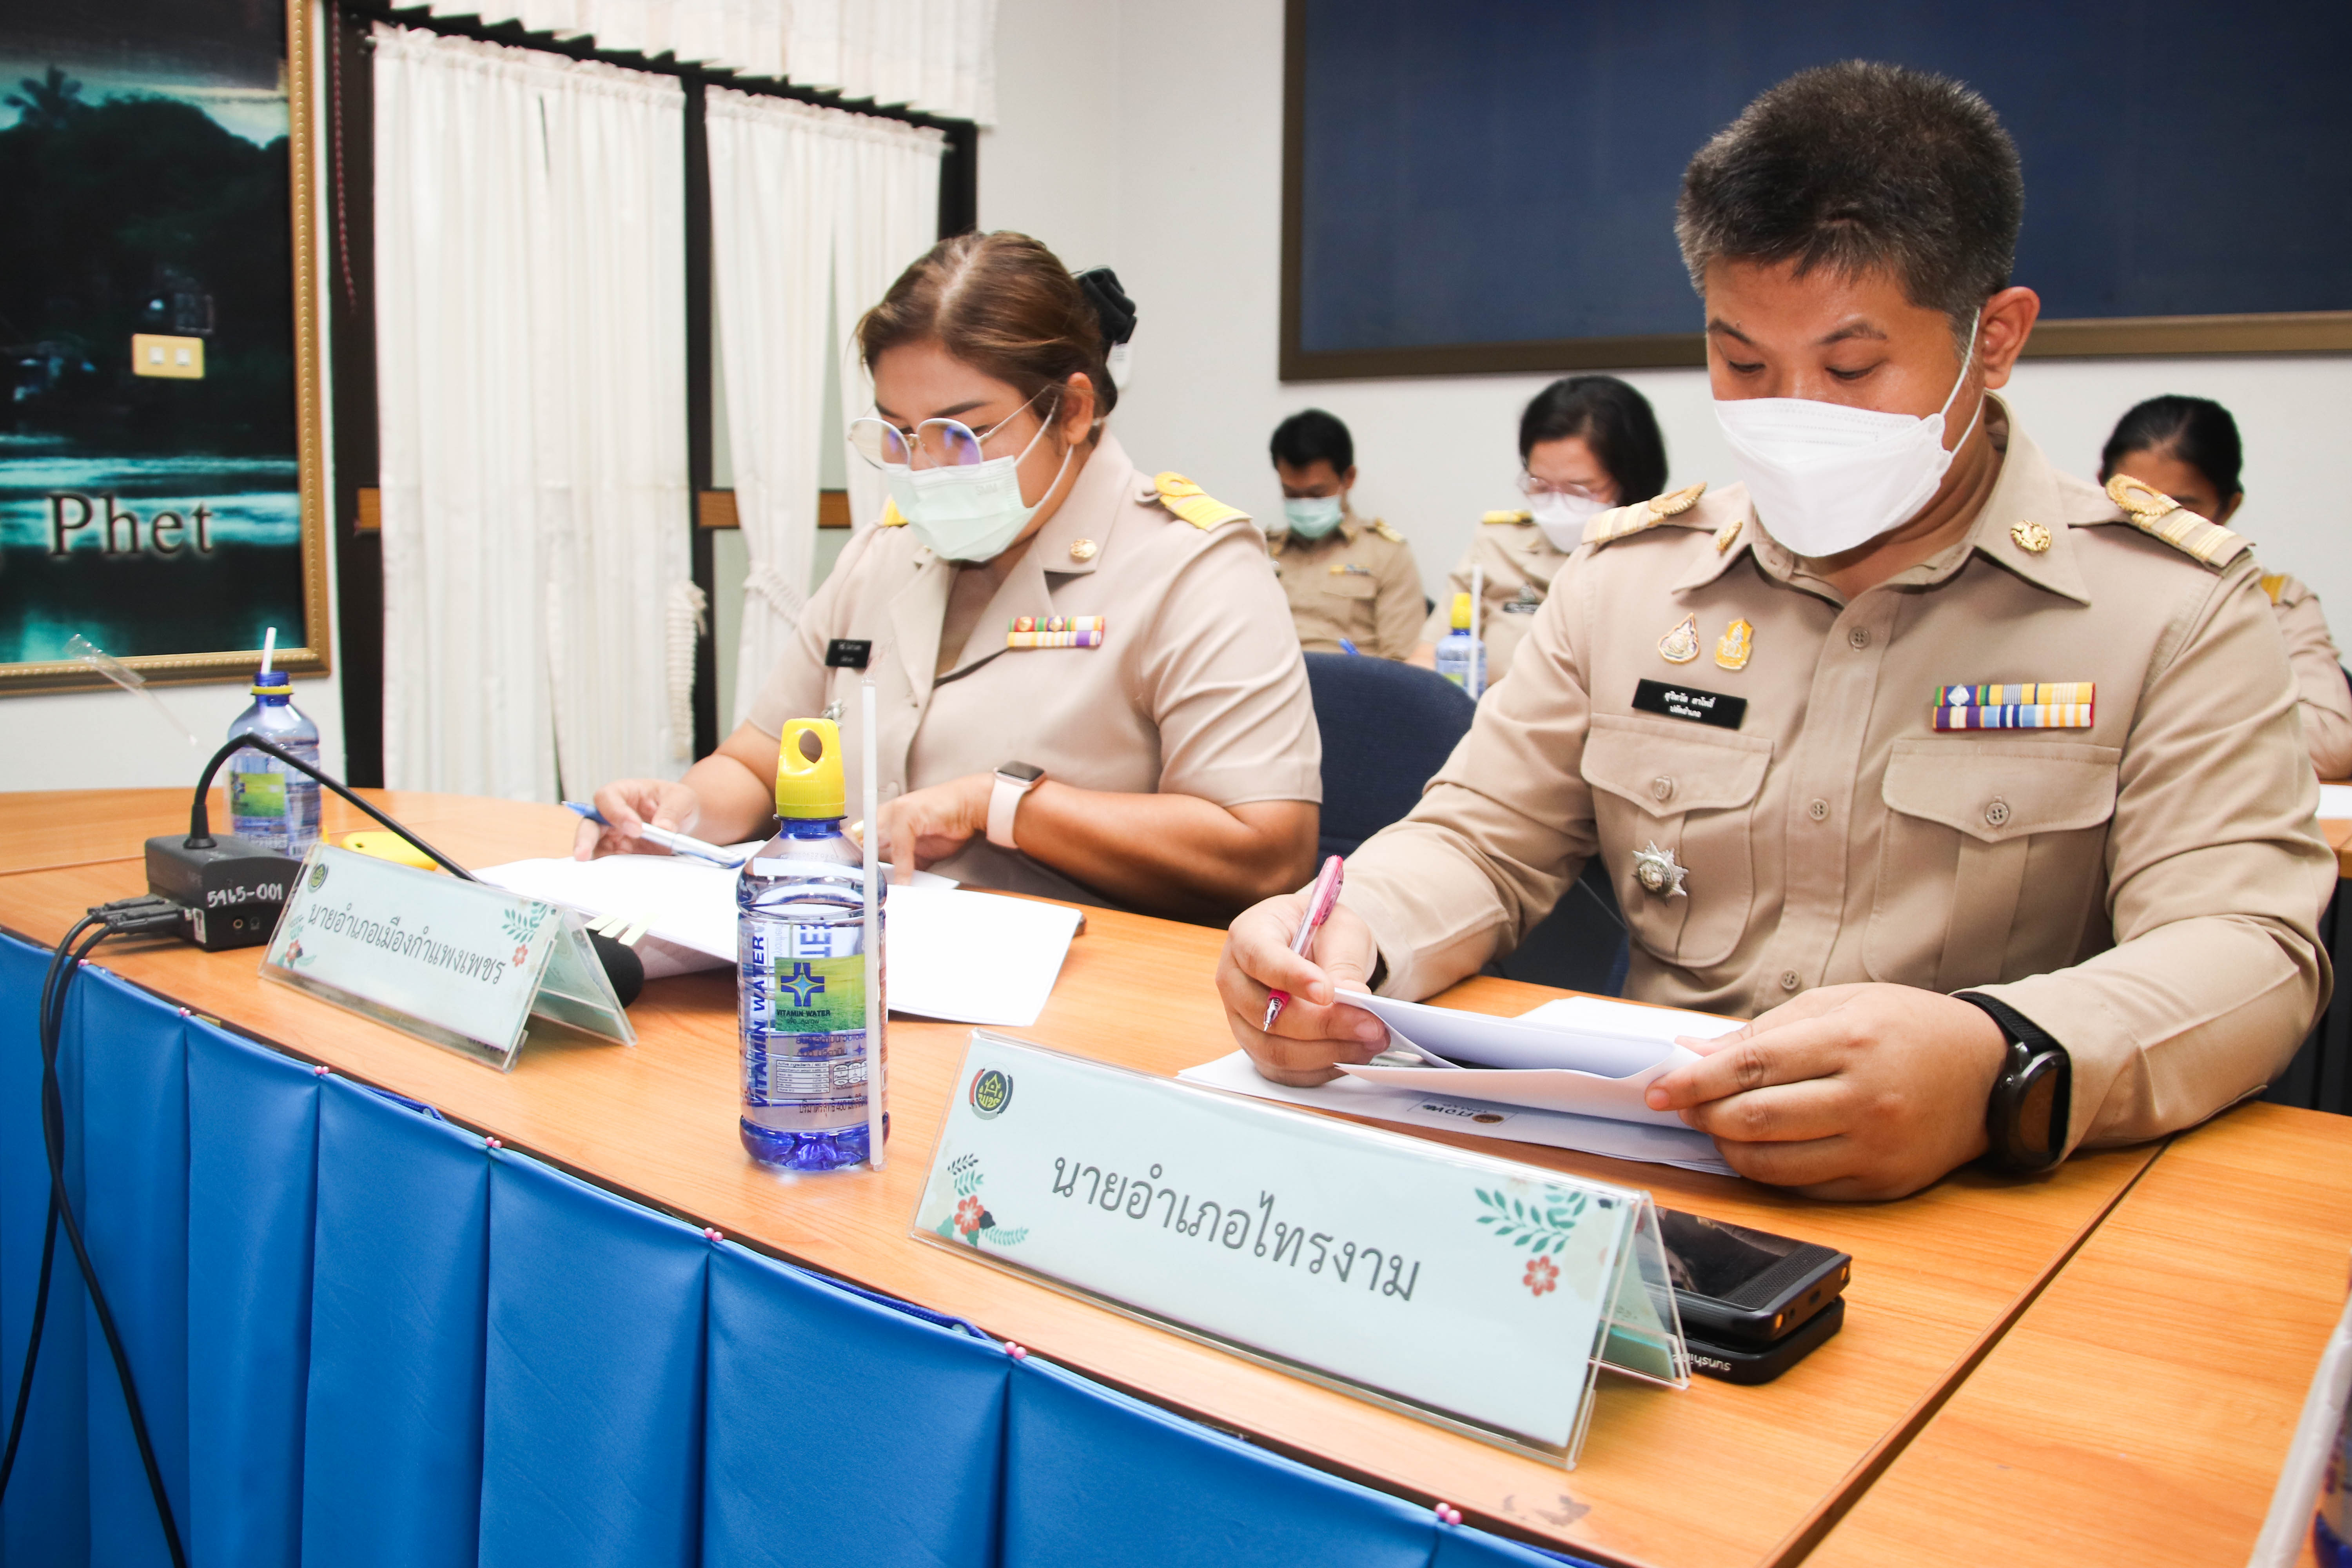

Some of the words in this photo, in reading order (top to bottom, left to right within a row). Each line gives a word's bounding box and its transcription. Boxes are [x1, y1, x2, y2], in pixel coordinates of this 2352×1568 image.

[45, 491, 214, 555] Phet
[307, 902, 506, 986] นายอำเภอเมืองกำแพงเพชร
[752, 936, 765, 1011] WATER
[753, 1020, 767, 1107] VITAMIN
[1051, 1156, 1421, 1302] นายอำเภอไทรงาม
